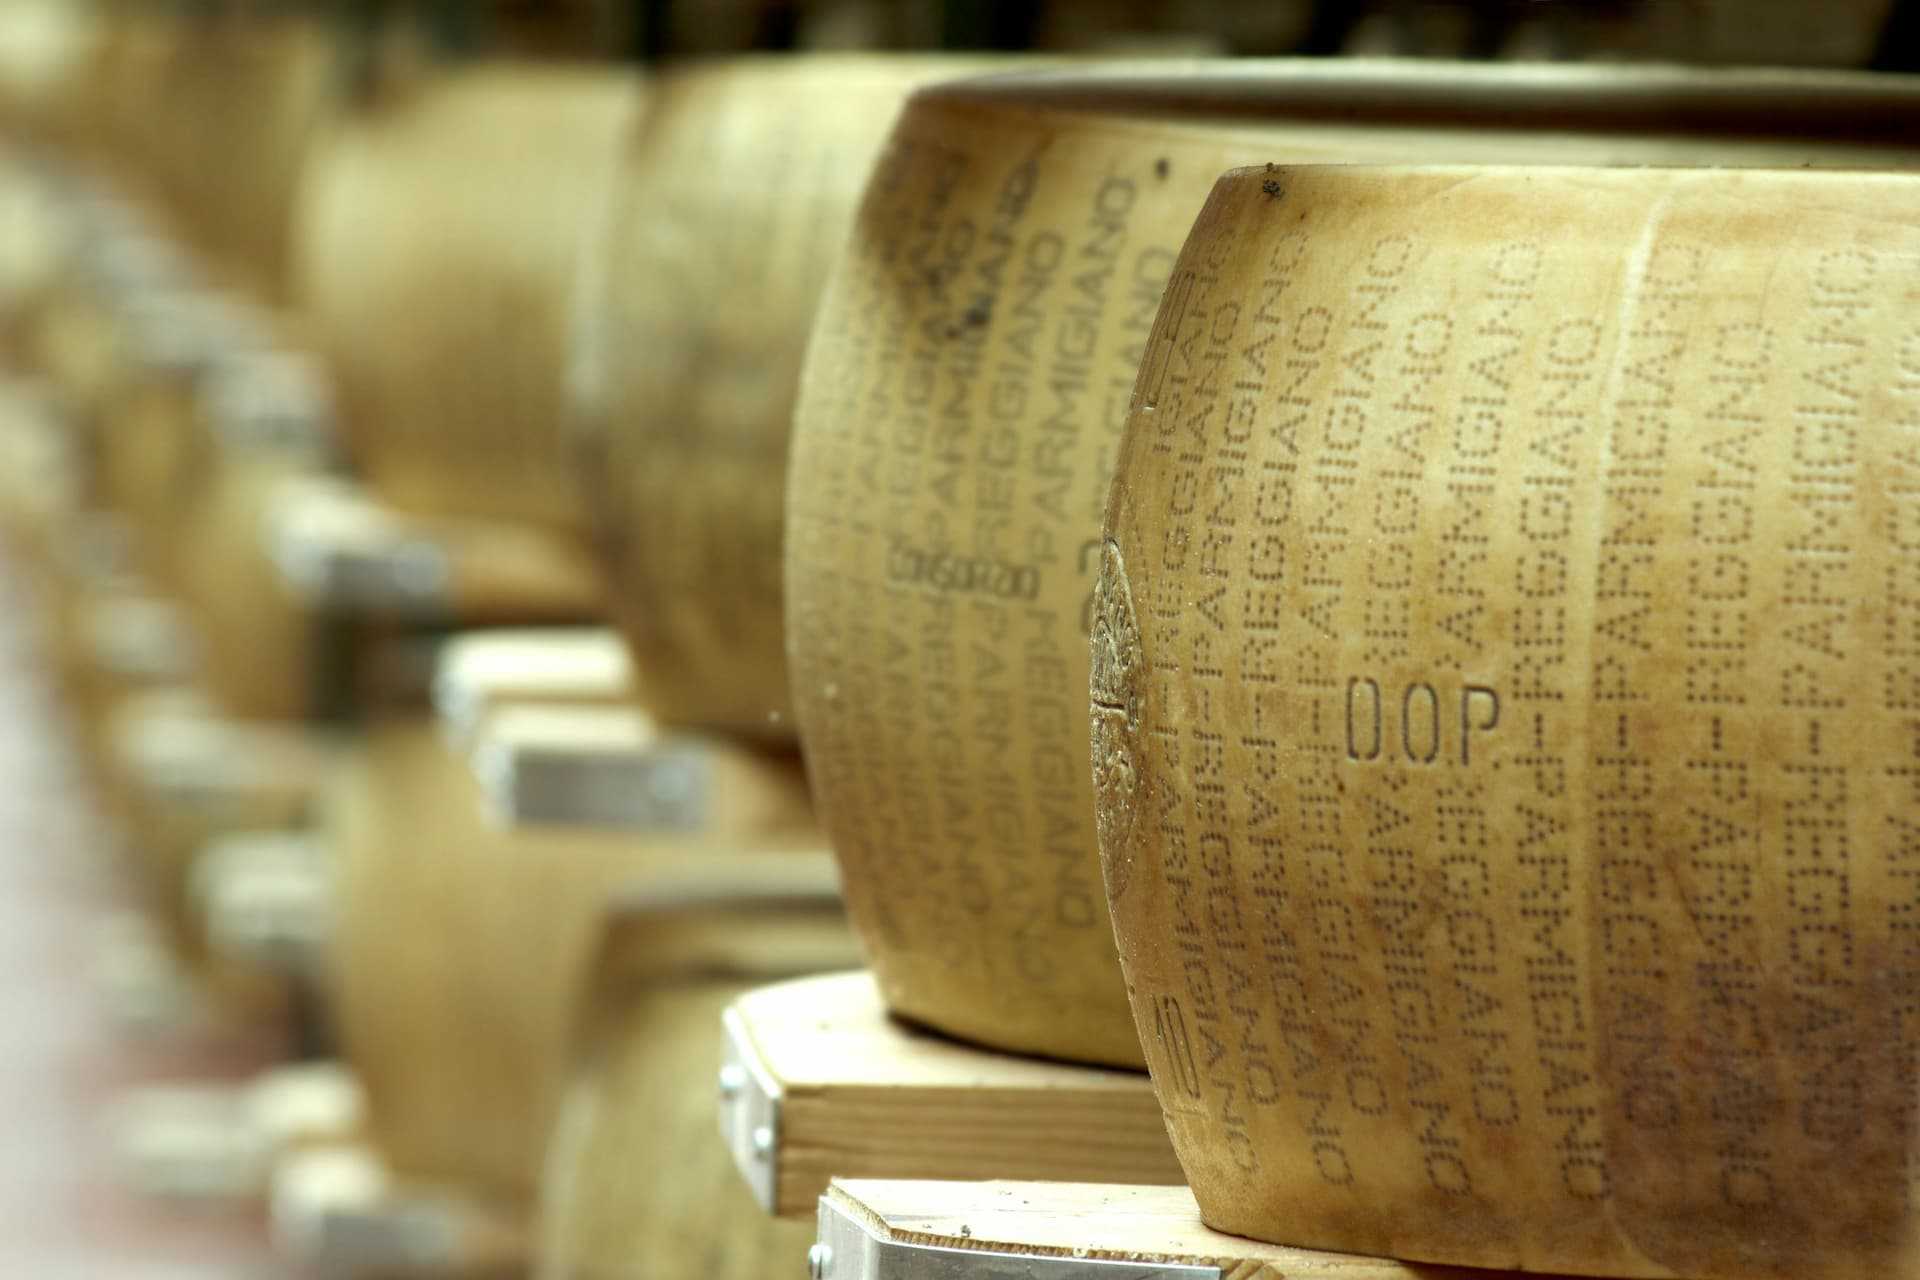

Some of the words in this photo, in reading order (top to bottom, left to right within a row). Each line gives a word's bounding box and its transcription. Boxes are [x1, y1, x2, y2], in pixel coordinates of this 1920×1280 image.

[1026, 173, 1138, 563] PARMIGIANO
[1152, 300, 1242, 671] REGGIANO
[1192, 229, 1309, 677] PARMIGIANO
[1241, 305, 1334, 684] REGGIANO
[1297, 233, 1413, 689] PARMIGIANO
[1434, 240, 1543, 671] ARMIGIANO
[1511, 317, 1603, 701] REGGIANO
[1594, 241, 1703, 701] PARMIGIANO
[1686, 322, 1776, 706] REGGIANO
[1780, 248, 1877, 707] PARMIGIANO
[1192, 730, 1283, 1106] REGGIANO
[1243, 738, 1355, 1187] PARMIGIANO
[1296, 744, 1389, 1117] REGGIANO
[1366, 770, 1472, 1199] ARMIGIANO
[1514, 758, 1614, 1202] PARMIGIANO
